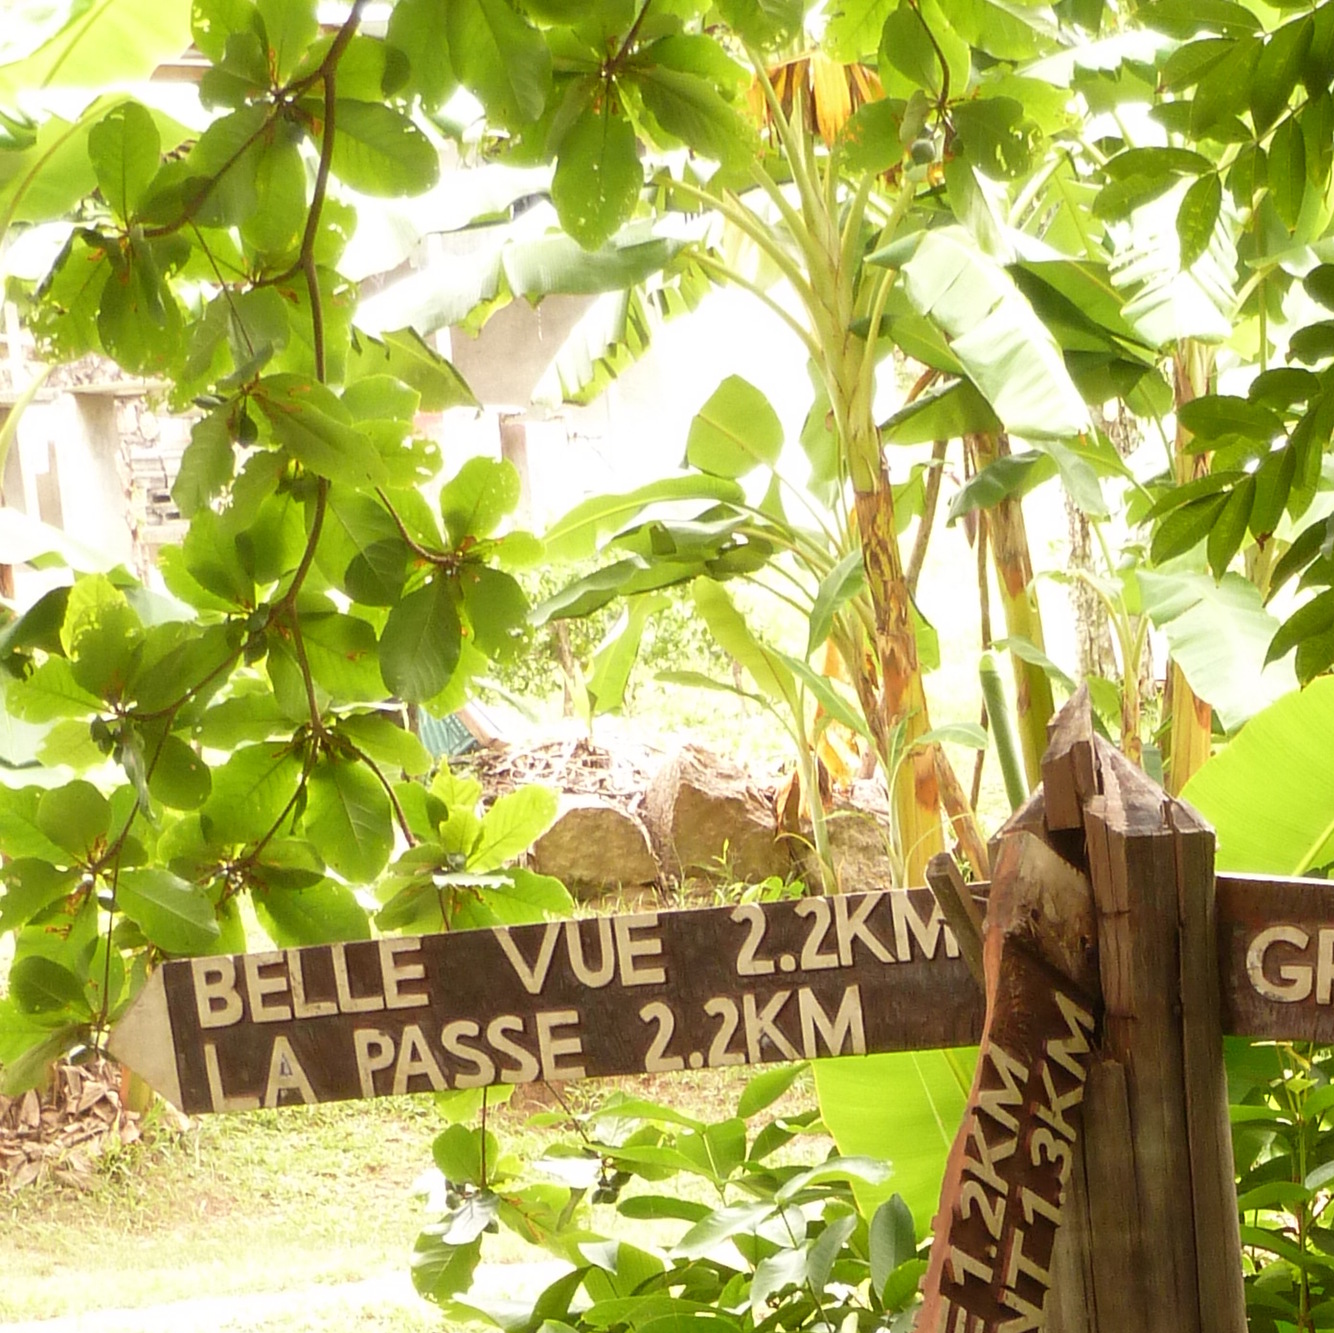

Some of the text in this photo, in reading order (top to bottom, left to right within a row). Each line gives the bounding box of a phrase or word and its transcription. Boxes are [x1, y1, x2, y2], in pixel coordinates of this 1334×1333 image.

[191, 888, 960, 1029] BELLE VUE 2.2KM
[204, 984, 867, 1113] LA PASSE 2.2KM
[949, 1040, 1029, 1286] 1.2KM
[1019, 990, 1095, 1228] 1.3KM
